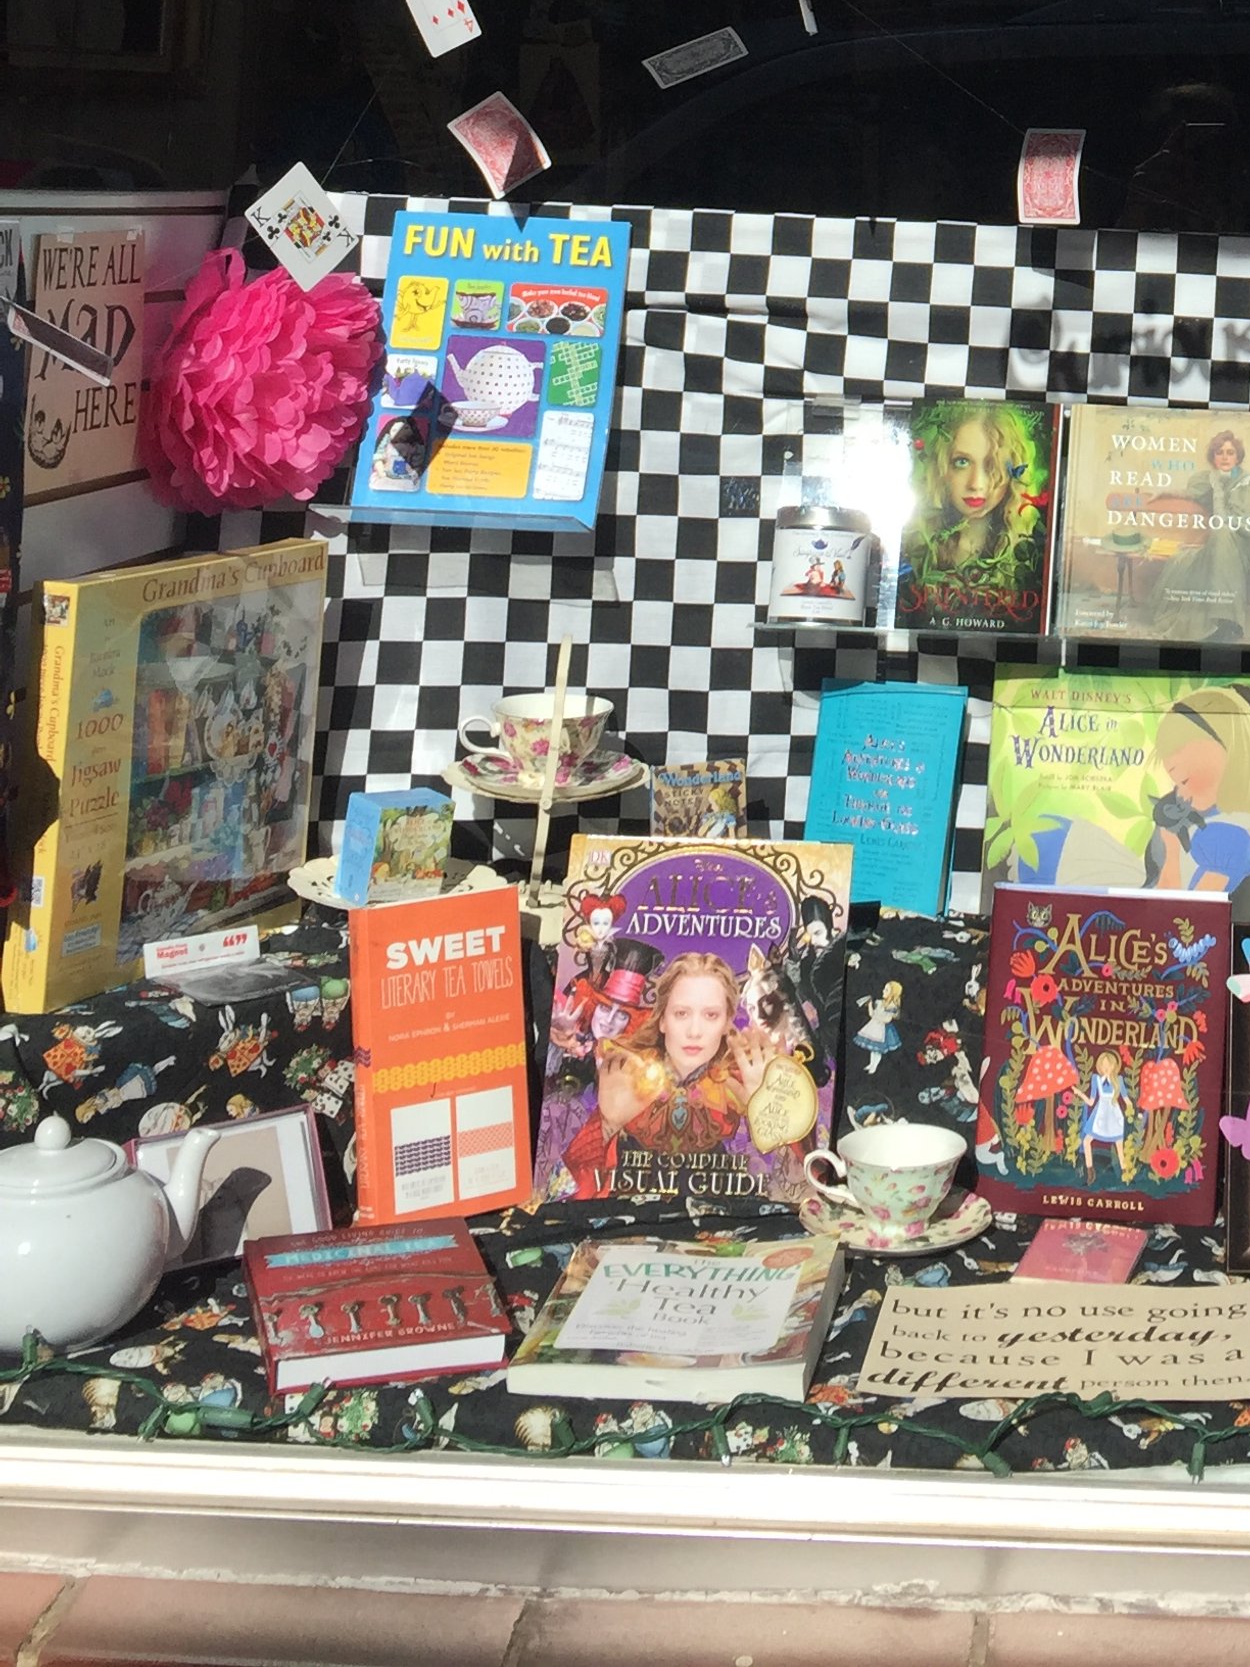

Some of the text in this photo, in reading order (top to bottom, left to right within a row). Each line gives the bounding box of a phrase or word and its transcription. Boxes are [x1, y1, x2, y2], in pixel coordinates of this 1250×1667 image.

[250, 206, 271, 227] K
[338, 226, 356, 248] K
[404, 224, 613, 268] FUN with TEA
[42, 243, 141, 291] WE'RE ALL
[73, 382, 138, 434] HERE
[1111, 433, 1199, 454] WOMEN
[1109, 469, 1172, 488] READ
[1151, 460, 1196, 473] WHO
[955, 617, 1006, 630] HOWARD
[45, 644, 66, 763] Grandma's Cupboard
[1030, 687, 1133, 705] WALT DISNEY'S
[76, 712, 124, 741] 1000
[1038, 705, 1119, 738] ALICE in
[1012, 734, 1145, 771] WONDERLAND
[69, 756, 122, 789] Jigsaw
[660, 768, 744, 786] Wonderland
[69, 787, 121, 819] Puzzle
[588, 849, 612, 865] DK
[626, 912, 783, 940] ADVENTURES
[386, 925, 506, 971] SWEET
[1038, 914, 1169, 978] ALICE'S
[380, 955, 515, 1011] LITERARY TEA TOWELS
[1057, 977, 1175, 999] ADVENTURES
[1099, 998, 1126, 1013] IN
[387, 1031, 410, 1043] NORA
[443, 1021, 451, 1033] &
[451, 1018, 487, 1031] SHERMAN
[1015, 986, 1199, 1055] WONDERLAND
[621, 1149, 750, 1172] THE COMPLETE
[593, 1167, 771, 1198] VISUAL GUIDE
[1041, 1194, 1145, 1212] LEWIS CARROLL
[602, 1262, 802, 1283] EVERYTHING
[615, 1278, 770, 1304] Healthy
[656, 1297, 718, 1316] Tea
[891, 1300, 1249, 1323] but it's no use going
[651, 1312, 712, 1327] Book
[323, 1322, 456, 1346] JENNIFER BROWNE
[891, 1325, 1233, 1350] back to yesterday,
[879, 1340, 1246, 1367] because I was a
[866, 1367, 1070, 1394] different
[1078, 1377, 1170, 1390] person
